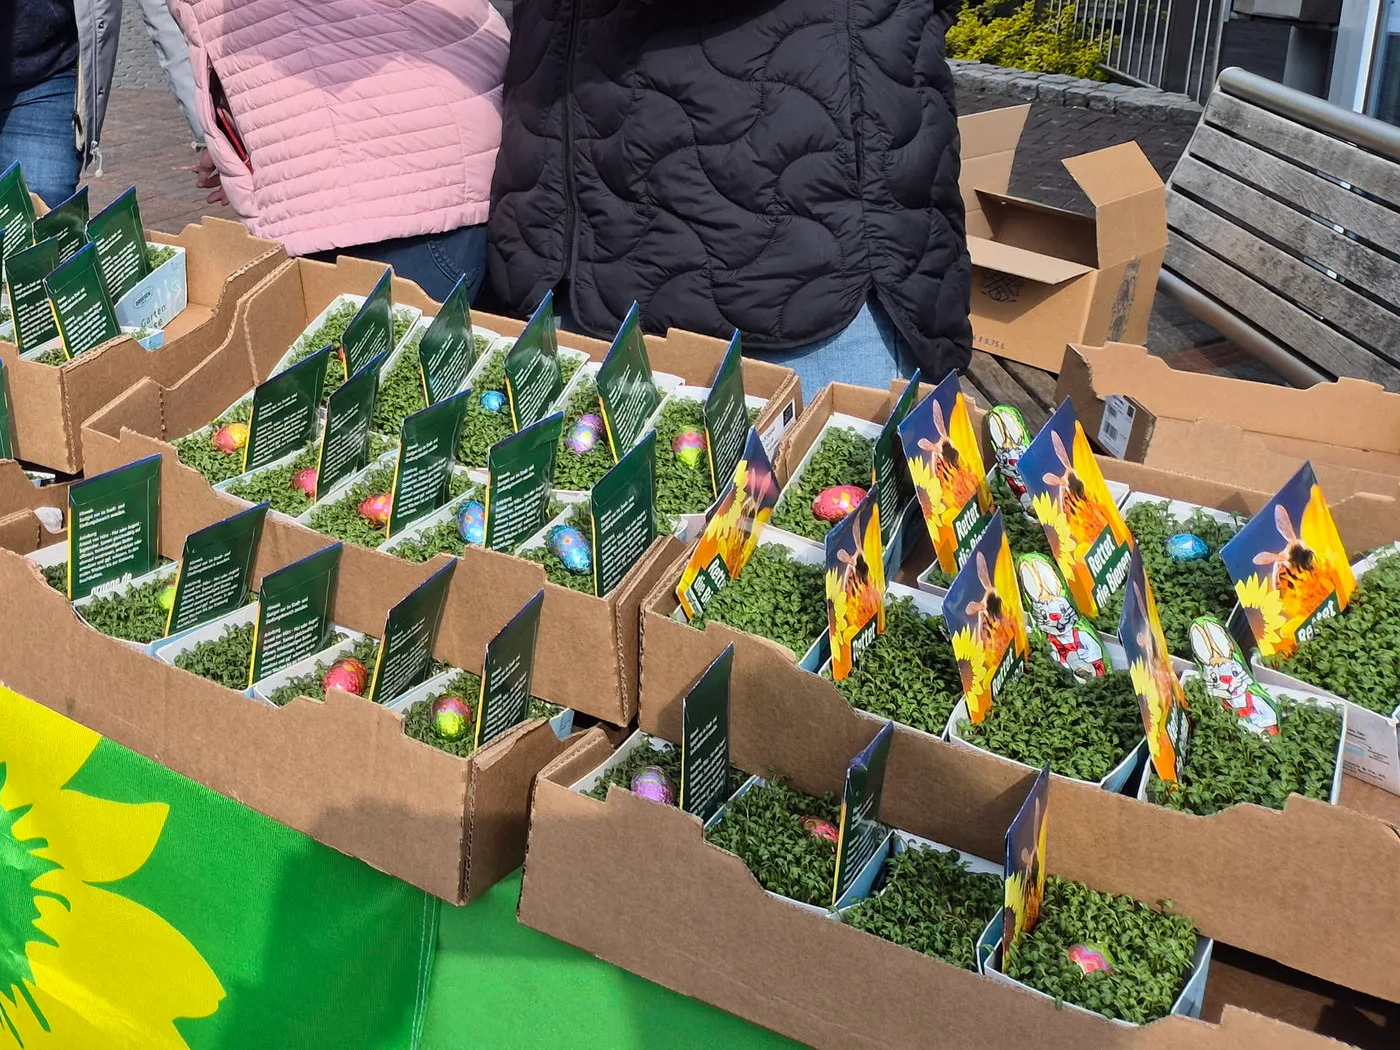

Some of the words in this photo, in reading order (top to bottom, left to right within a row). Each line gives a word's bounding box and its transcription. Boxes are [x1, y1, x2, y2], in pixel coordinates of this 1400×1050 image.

[955, 502, 980, 542] Rettet
[1087, 533, 1116, 578] Rettet
[708, 558, 727, 590] Rett
[1096, 583, 1111, 609] die
